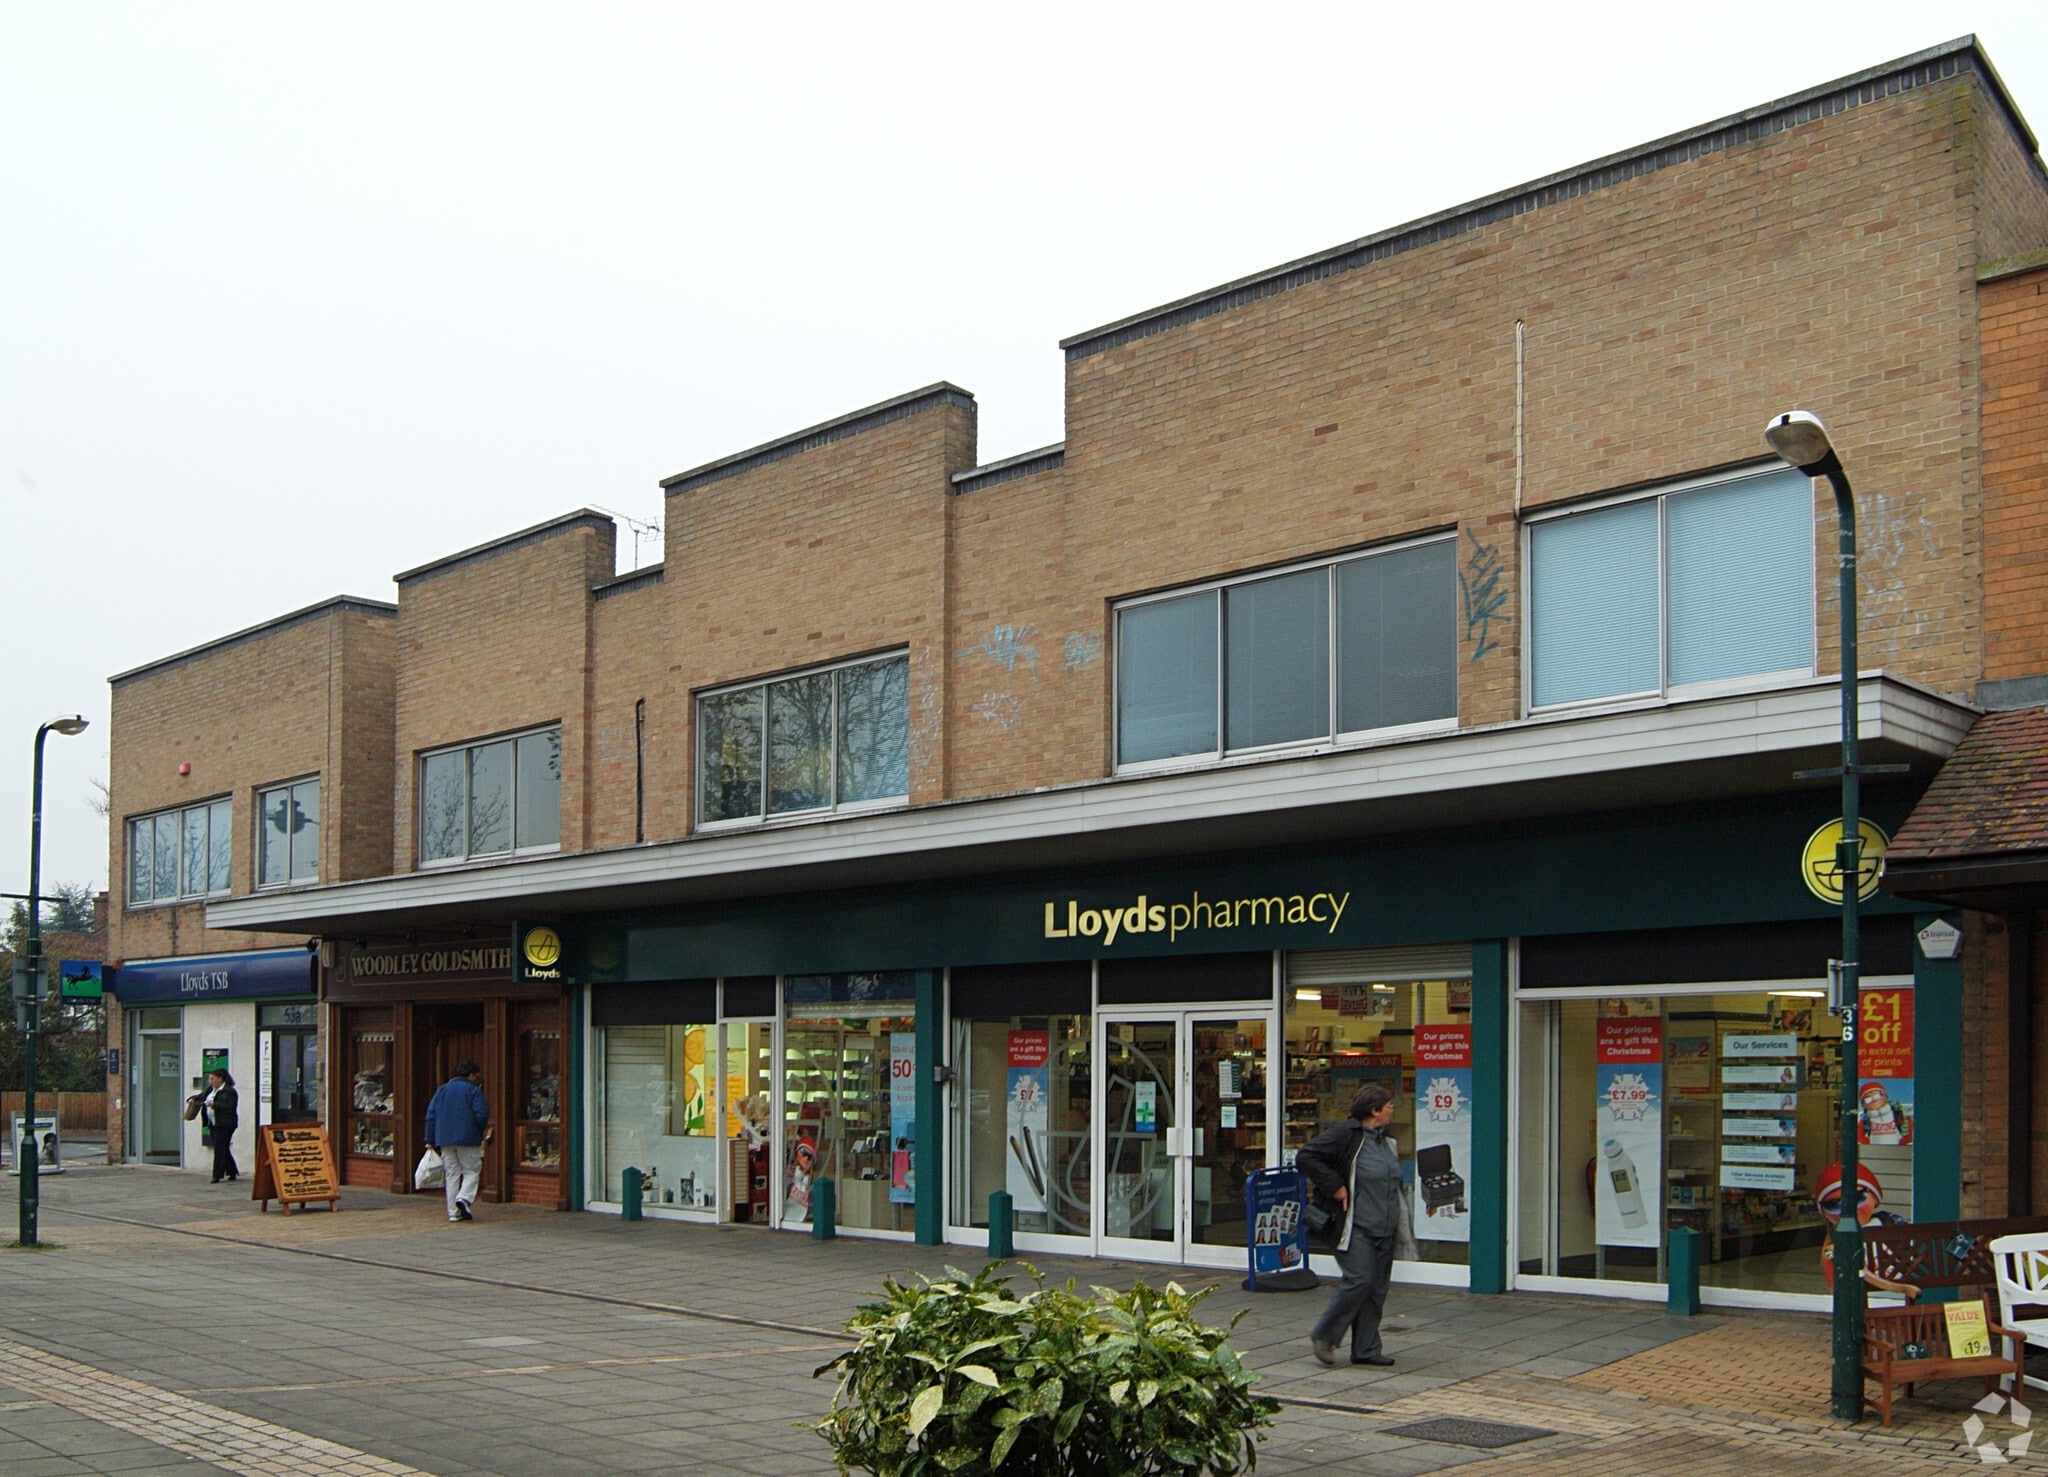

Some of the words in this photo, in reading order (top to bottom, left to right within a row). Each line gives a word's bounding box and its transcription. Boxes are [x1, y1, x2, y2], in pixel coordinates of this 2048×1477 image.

[1045, 890, 1350, 946] Lloydspharmacy
[352, 953, 419, 977] WOODLEY
[524, 967, 561, 981] Lloyds
[180, 971, 209, 997] Lloyds
[211, 971, 229, 990] TSB
[1862, 992, 1901, 1022] £1
[1624, 1026, 1653, 1035] prices
[1863, 1022, 1902, 1044] off
[1025, 1036, 1042, 1045] prices
[1423, 1033, 1438, 1041] Our
[1439, 1033, 1464, 1042] prices
[1625, 1036, 1639, 1046] gift
[1642, 1036, 1659, 1044] this
[1024, 1045, 1034, 1054] gift
[1417, 1043, 1430, 1051] are
[1439, 1042, 1453, 1052] gift
[1454, 1042, 1470, 1050] this
[1668, 1042, 1677, 1058] 3
[1697, 1041, 1710, 1058] 2
[1732, 1041, 1749, 1050] Our
[1751, 1040, 1789, 1050] Services
[1606, 1047, 1651, 1056] Christmas
[1868, 1047, 1894, 1056] extra
[1895, 1047, 1911, 1055] set
[1335, 1056, 1370, 1066] SAVING
[1380, 1056, 1398, 1067] VAT
[1423, 1053, 1464, 1061] Christmas
[1861, 1058, 1872, 1067] of
[1874, 1058, 1902, 1068] prints
[1612, 1089, 1646, 1101] £7.99
[1434, 1094, 1453, 1109] £9
[1948, 1311, 1980, 1322] VALUE
